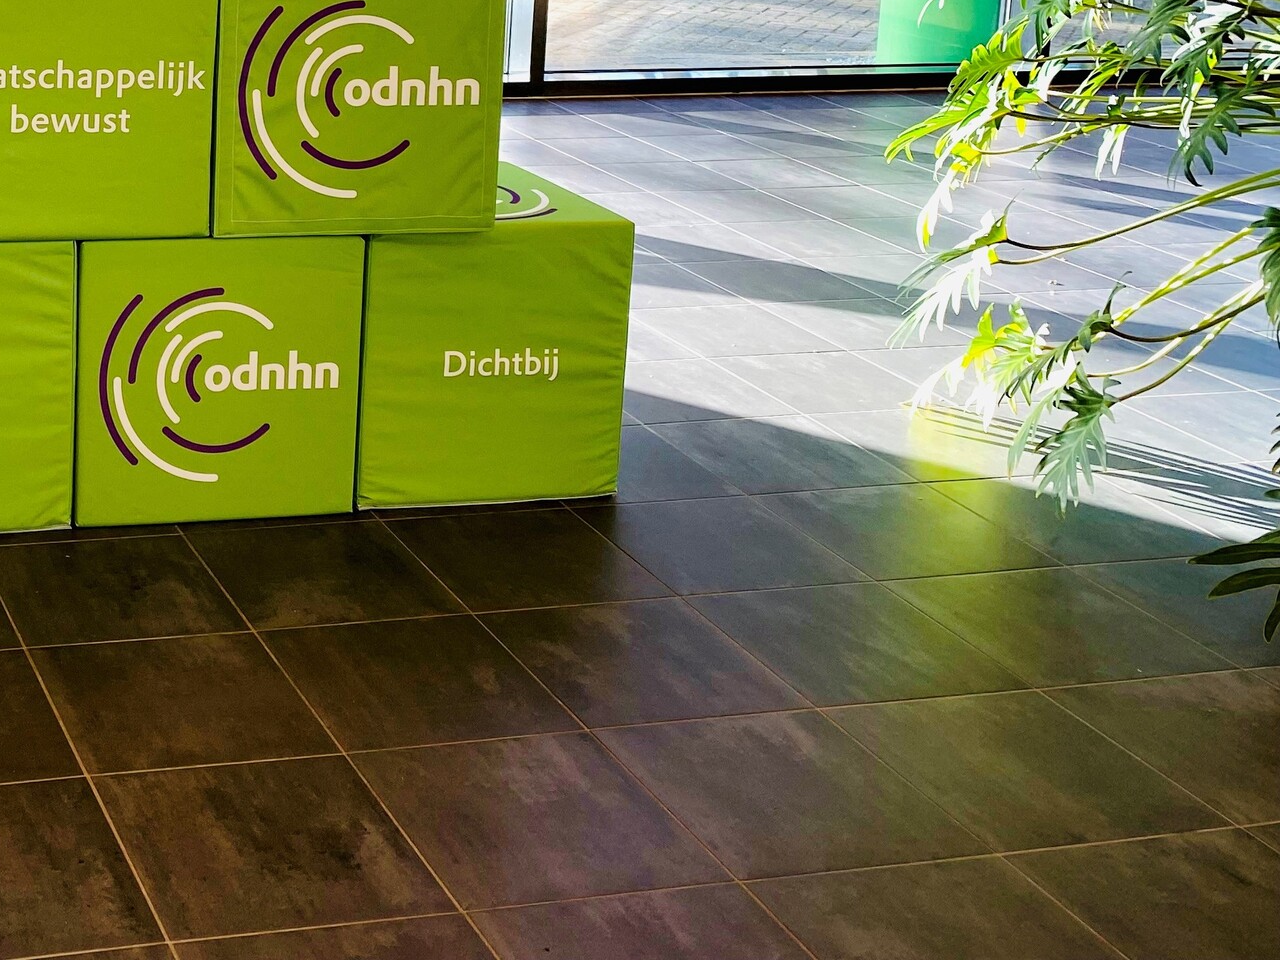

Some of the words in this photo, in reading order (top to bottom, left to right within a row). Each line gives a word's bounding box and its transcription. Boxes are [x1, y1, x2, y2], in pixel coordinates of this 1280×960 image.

[343, 65, 480, 107] odnhn
[11, 105, 130, 133] bewust
[204, 350, 339, 392] odnhn
[443, 348, 559, 381] Dichtbij
